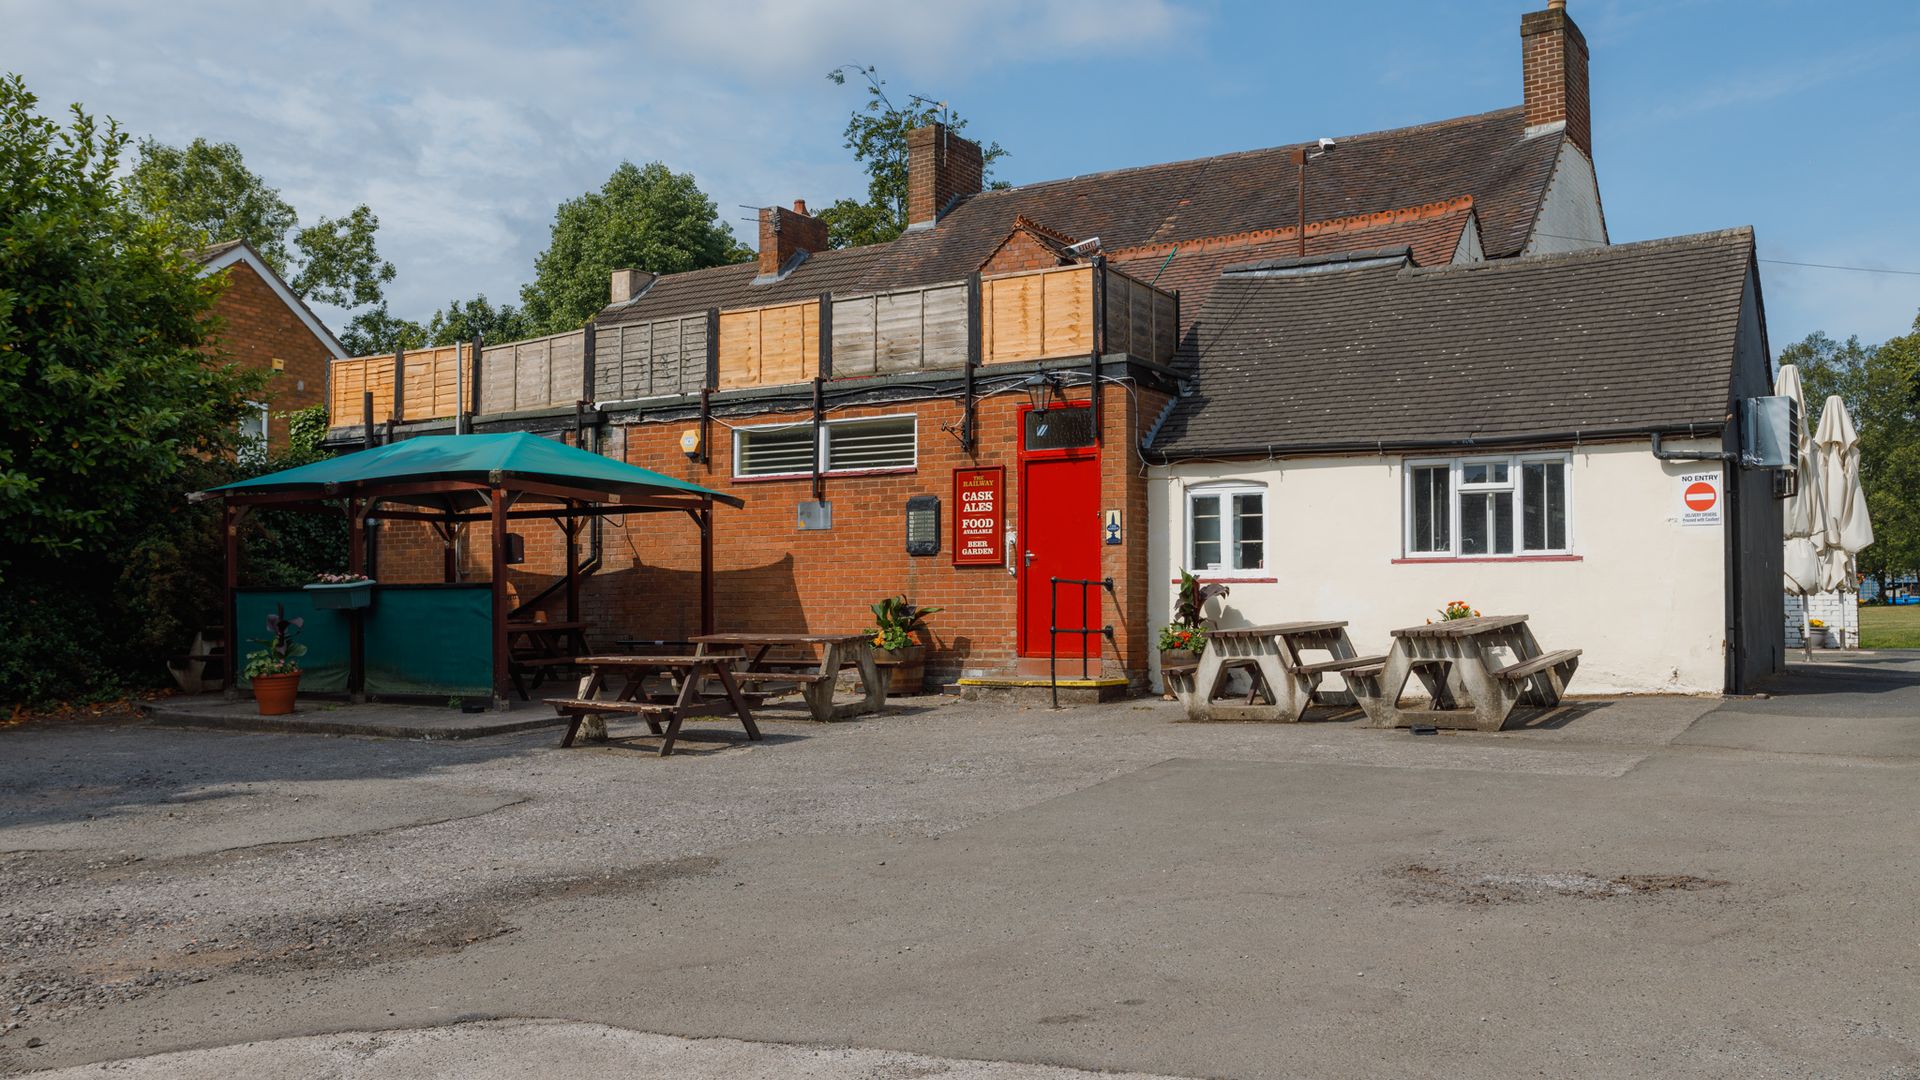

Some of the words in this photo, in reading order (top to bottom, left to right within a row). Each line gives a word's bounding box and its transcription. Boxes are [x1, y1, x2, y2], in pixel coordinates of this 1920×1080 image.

[962, 491, 993, 501] CASK
[963, 502, 993, 512] ALES
[962, 518, 994, 528] FOOD
[962, 548, 994, 556] GARDEN
